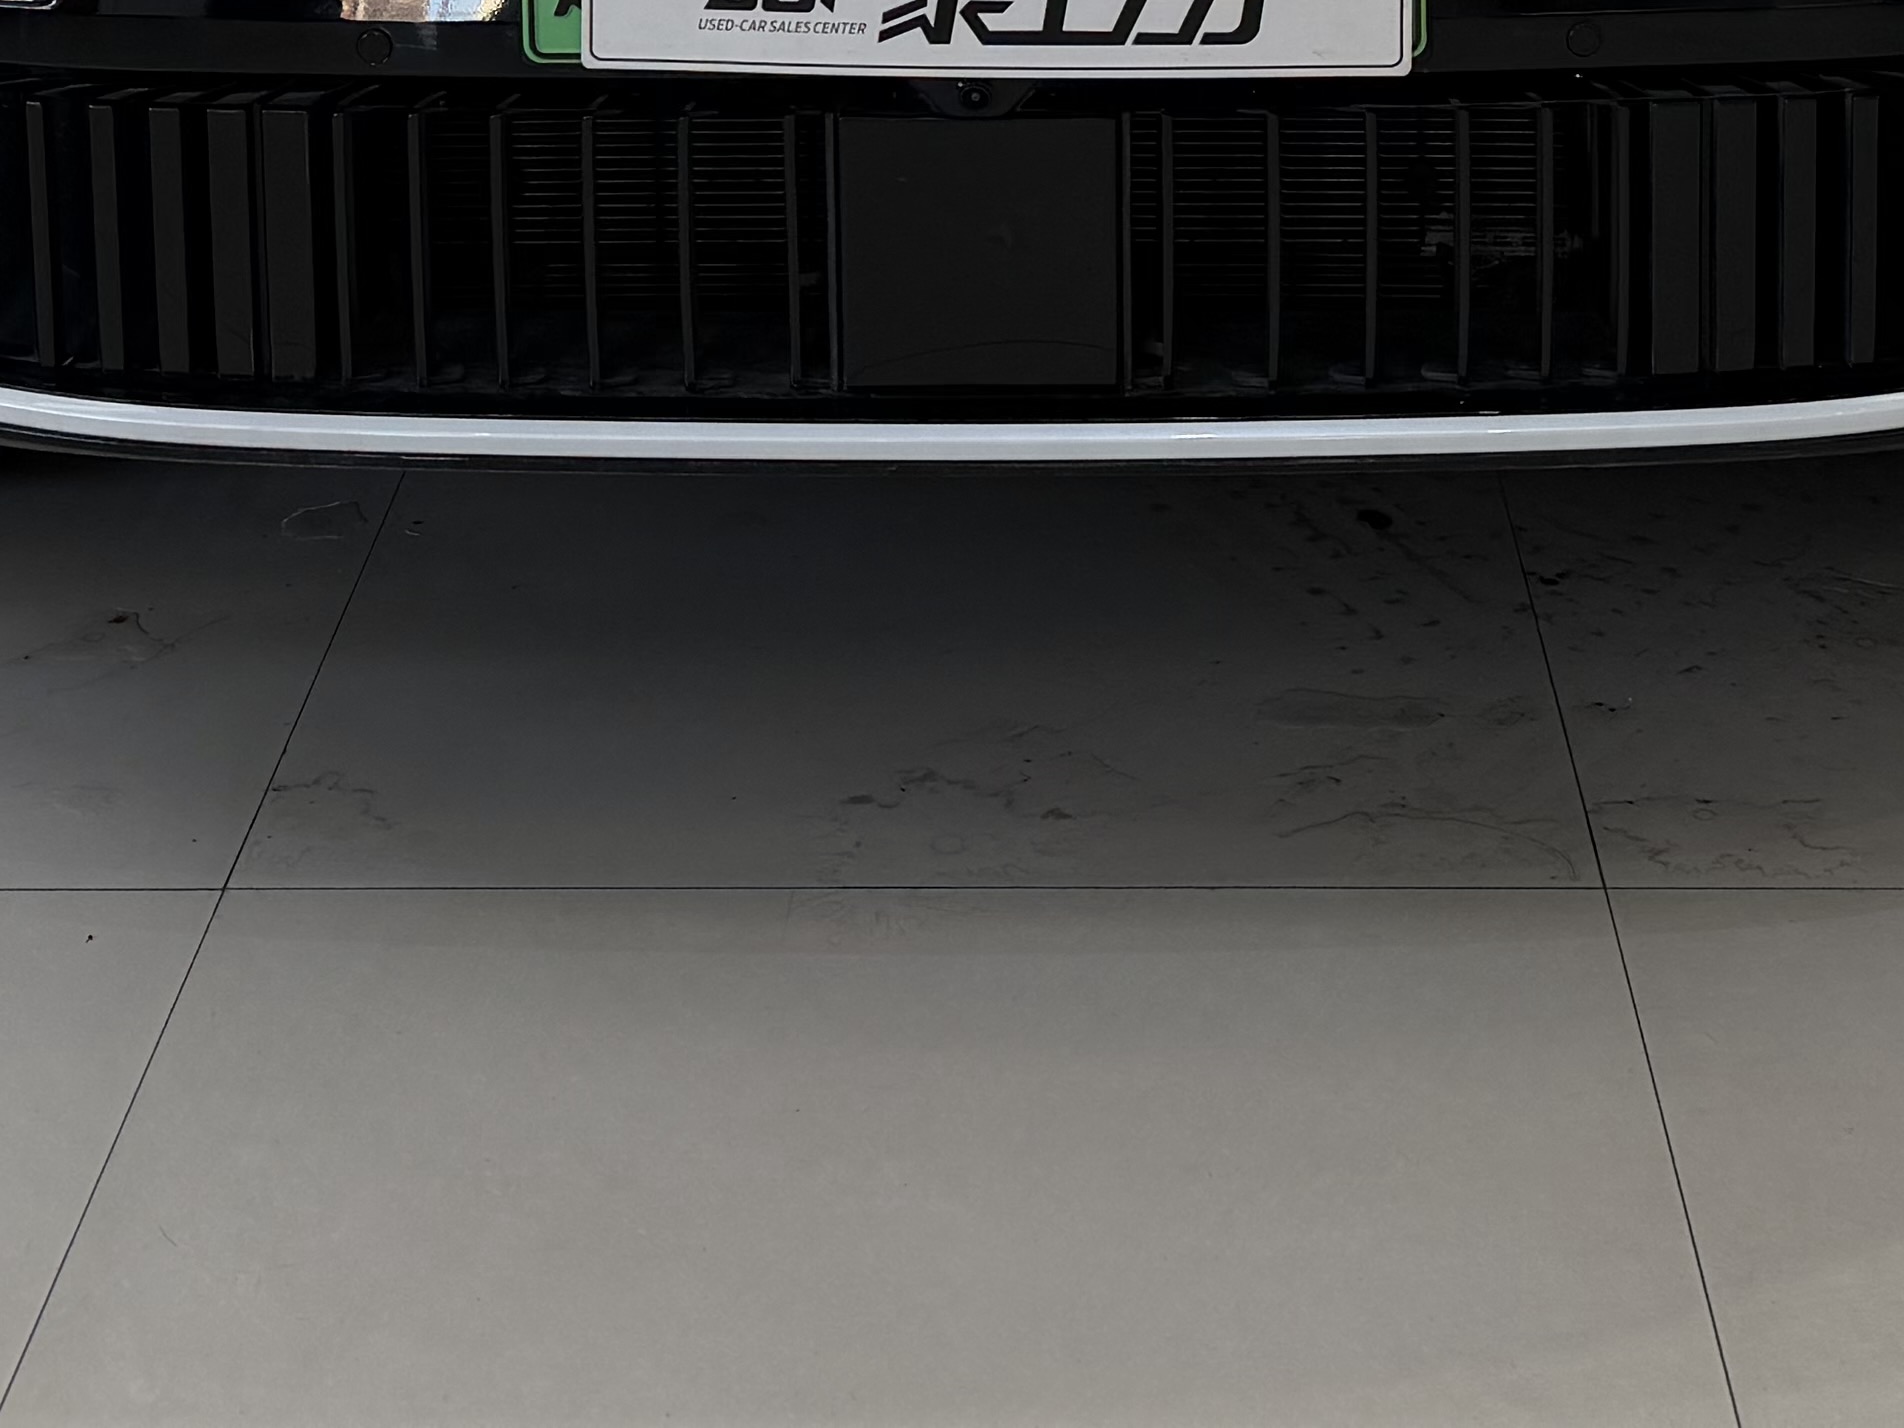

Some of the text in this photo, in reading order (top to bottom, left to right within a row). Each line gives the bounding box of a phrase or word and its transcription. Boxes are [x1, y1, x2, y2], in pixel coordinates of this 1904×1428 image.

[698, 18, 867, 34] USED-CAR SALES CENTER
